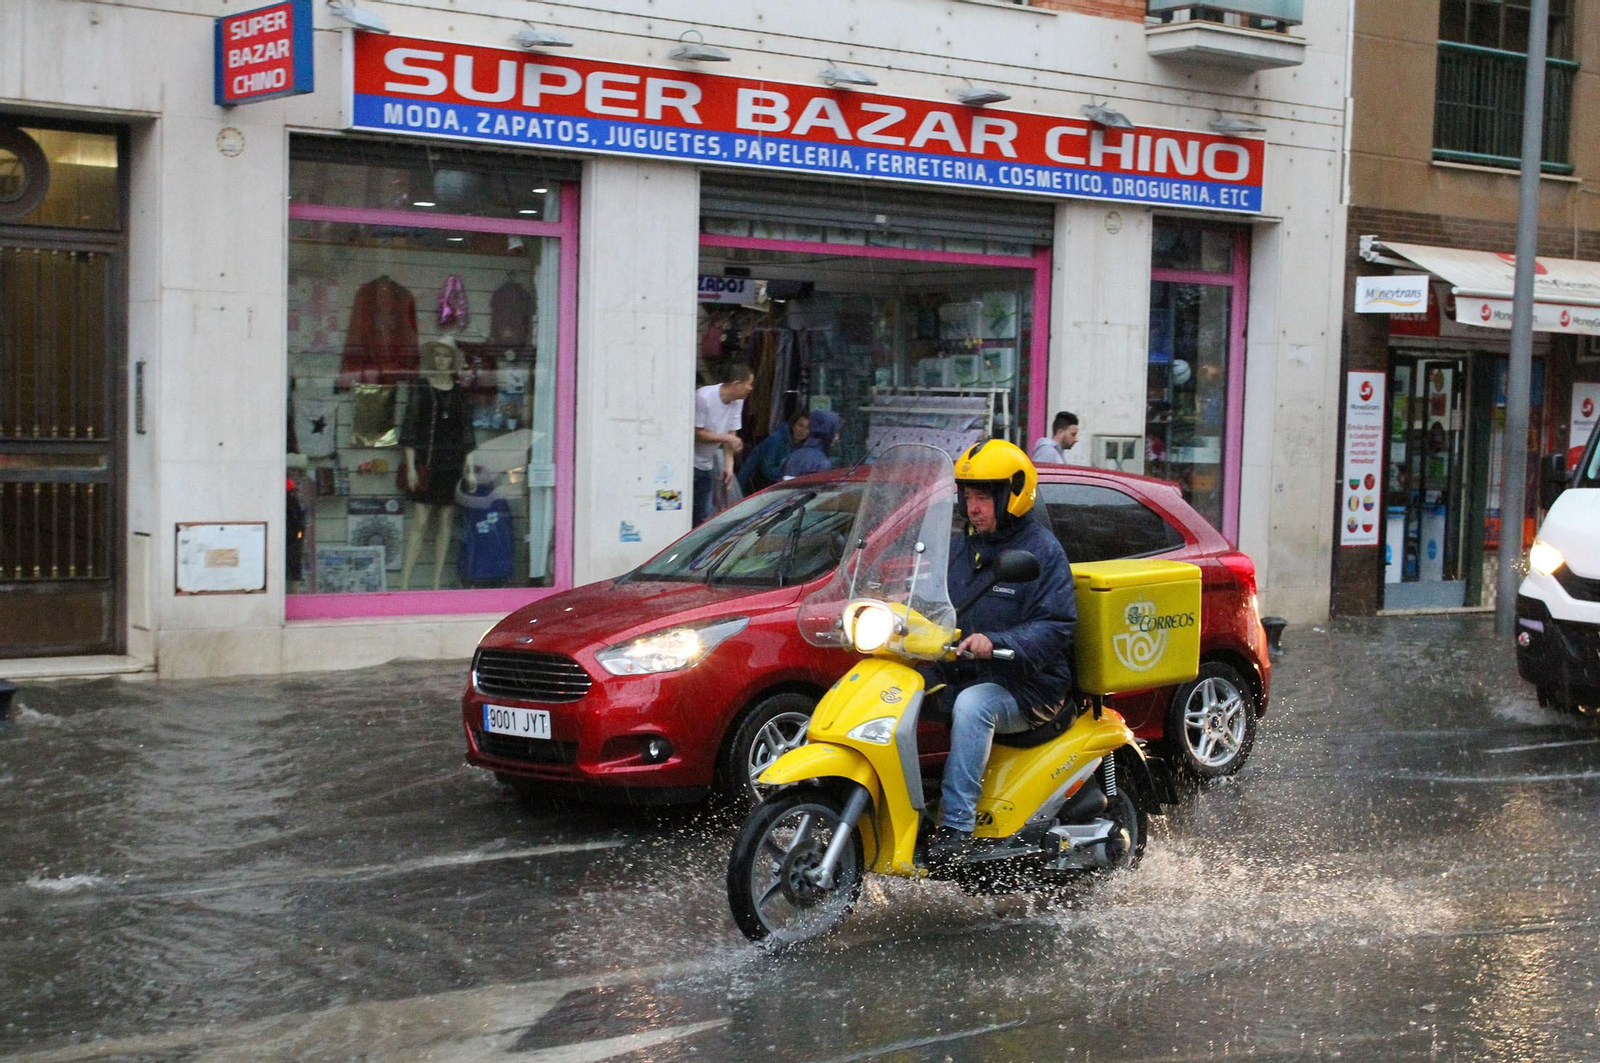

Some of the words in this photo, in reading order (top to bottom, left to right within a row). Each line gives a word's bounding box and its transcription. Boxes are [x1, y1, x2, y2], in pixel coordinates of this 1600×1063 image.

[229, 11, 287, 40] SUPER
[228, 38, 290, 68] BAZAR
[233, 67, 286, 94] CHINO
[384, 47, 703, 125] SUPER
[736, 88, 1018, 158] BAZAR
[1045, 125, 1250, 181] CHINO
[383, 102, 469, 134] MODA,
[476, 112, 597, 146] ZAPATOS,
[604, 126, 728, 159] JUGUETES,
[735, 138, 860, 172] PAPELERIA,
[866, 152, 994, 184] FERRETERIA,
[998, 166, 1108, 196] COSMETICO,
[1112, 177, 1216, 205] DROGUERIA,
[1220, 187, 1249, 207] ETC
[1365, 287, 1422, 300] Moneytrans
[1140, 612, 1195, 632] CORREOS
[489, 708, 516, 731] 9001
[523, 712, 546, 734] JYT
